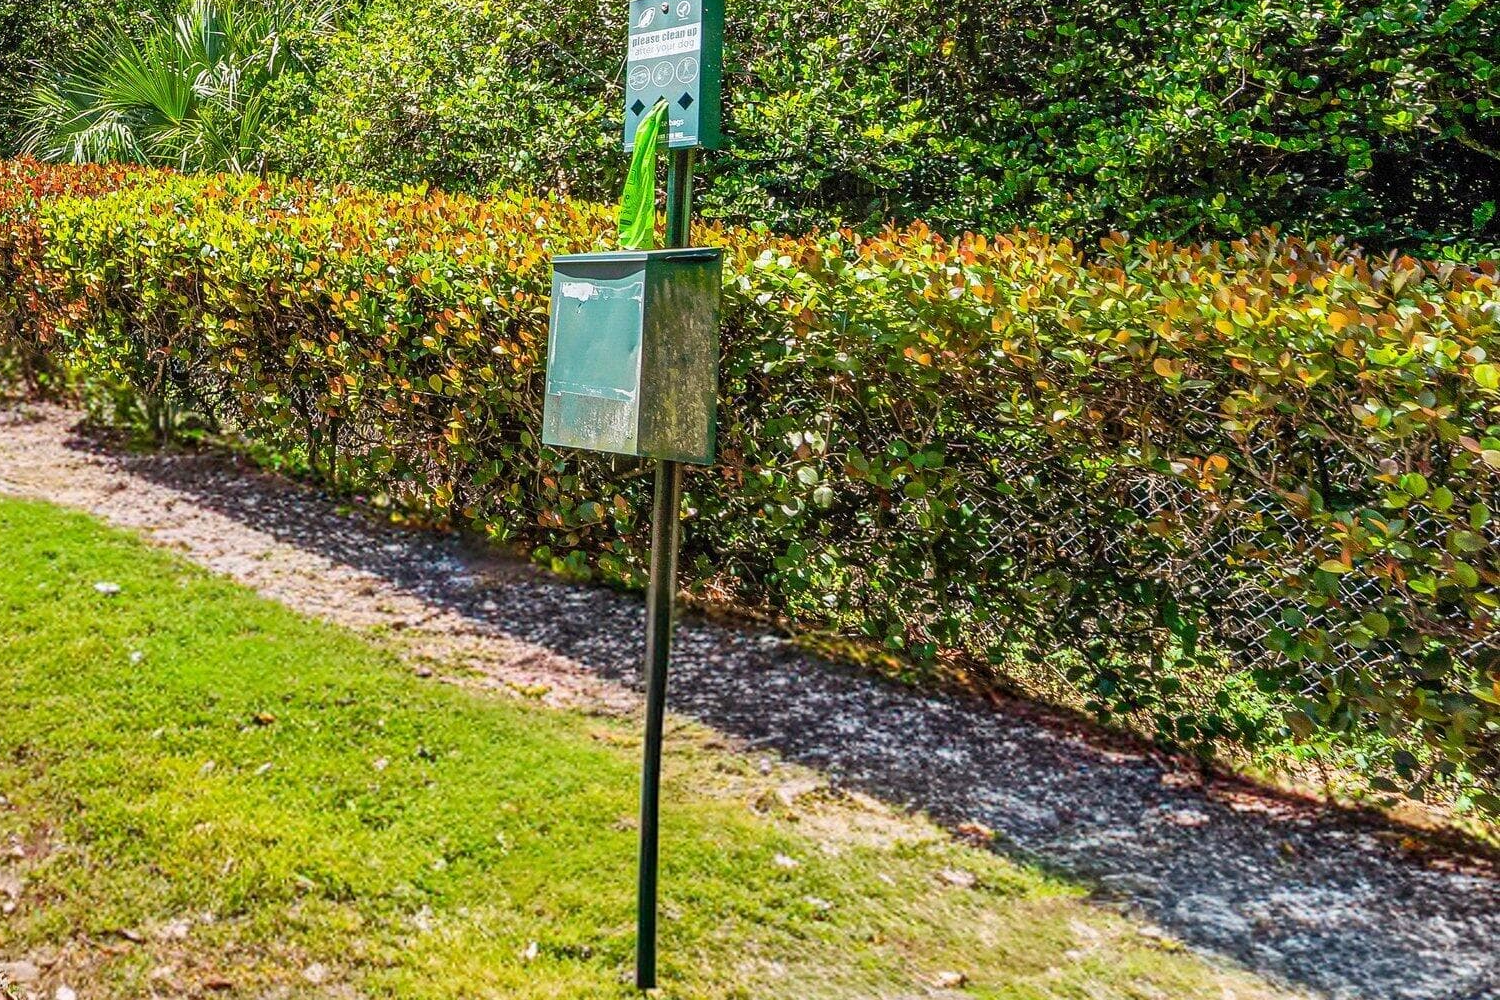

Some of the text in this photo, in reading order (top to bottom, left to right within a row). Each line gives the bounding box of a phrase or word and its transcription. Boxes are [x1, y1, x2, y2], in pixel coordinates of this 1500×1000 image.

[632, 27, 698, 48] please clean up
[634, 38, 695, 56] after your dog
